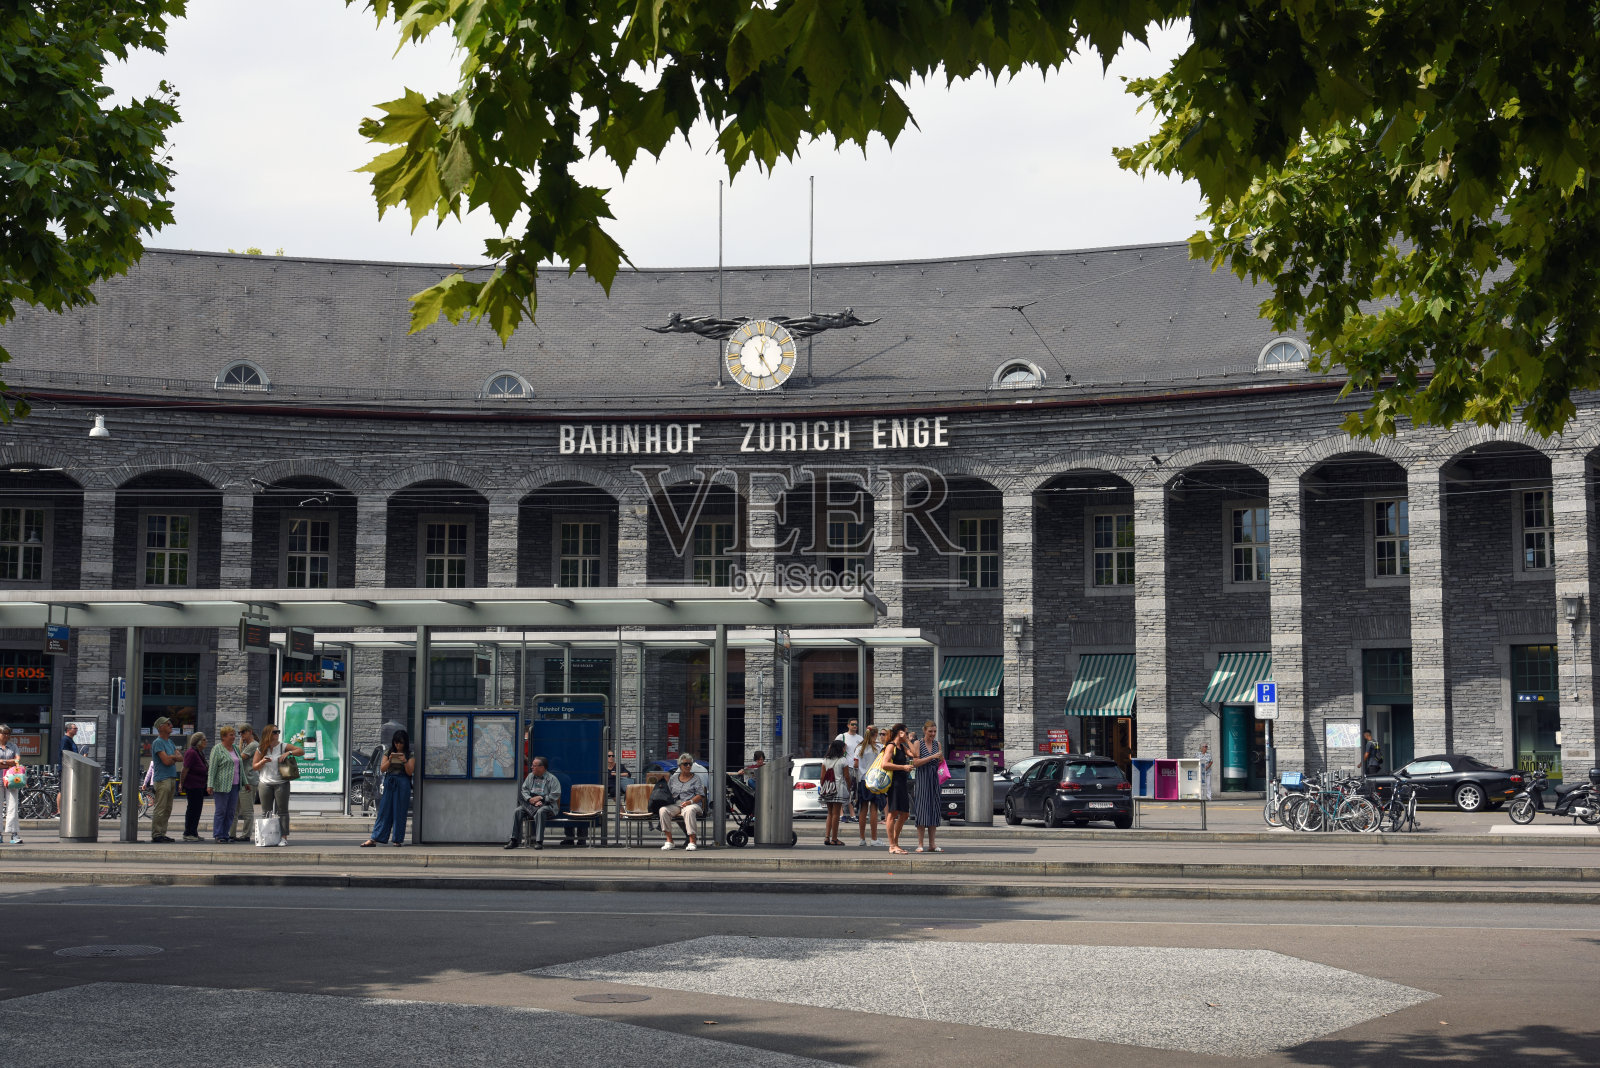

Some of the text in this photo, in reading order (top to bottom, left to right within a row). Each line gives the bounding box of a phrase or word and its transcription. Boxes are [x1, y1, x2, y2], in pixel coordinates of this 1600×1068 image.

[559, 424, 701, 454] BAHNHOF
[872, 416, 949, 450] ENGE
[282, 671, 321, 683] MIGRO
[1263, 684, 1270, 694] P
[297, 767, 334, 775] gentropfen
